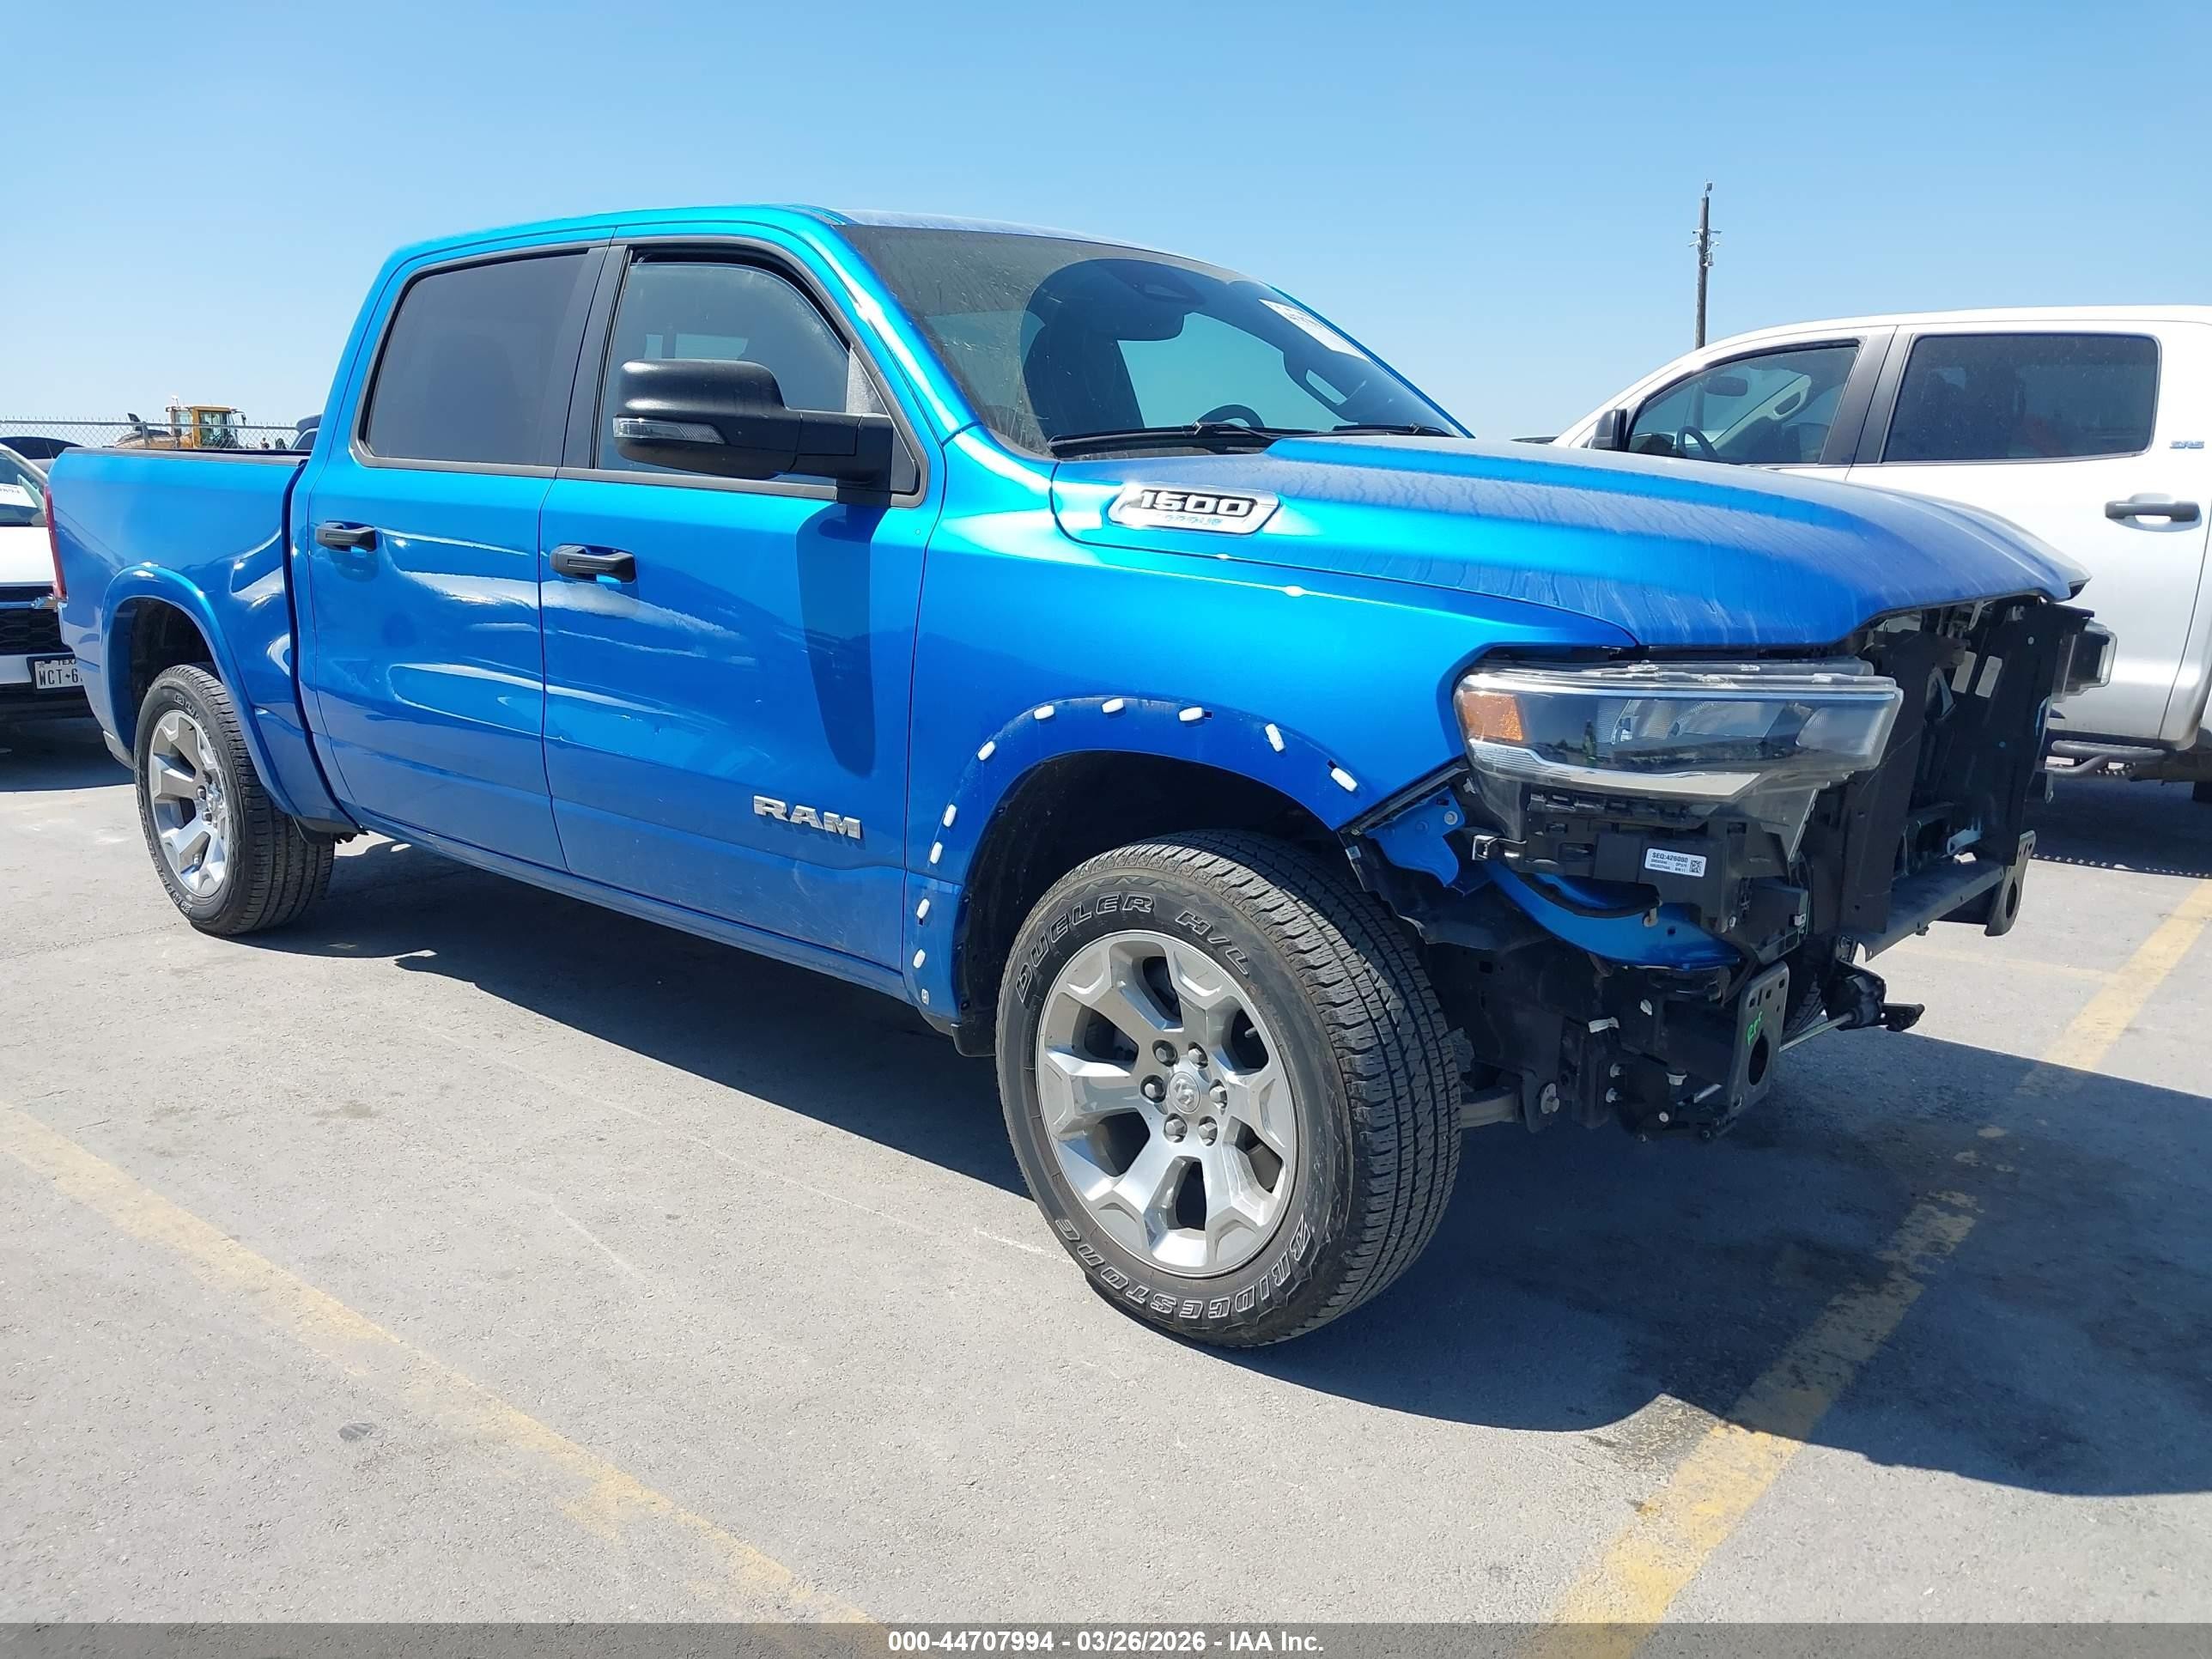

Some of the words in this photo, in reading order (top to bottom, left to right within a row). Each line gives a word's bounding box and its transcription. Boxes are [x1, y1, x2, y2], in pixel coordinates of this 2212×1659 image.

[1139, 489, 1253, 517] 1500
[753, 795, 861, 840] RAM
[1015, 891, 1156, 1004] DUELER
[1175, 910, 1250, 976] H/L
[1054, 1212, 1312, 1320] BRIDGESTONE
